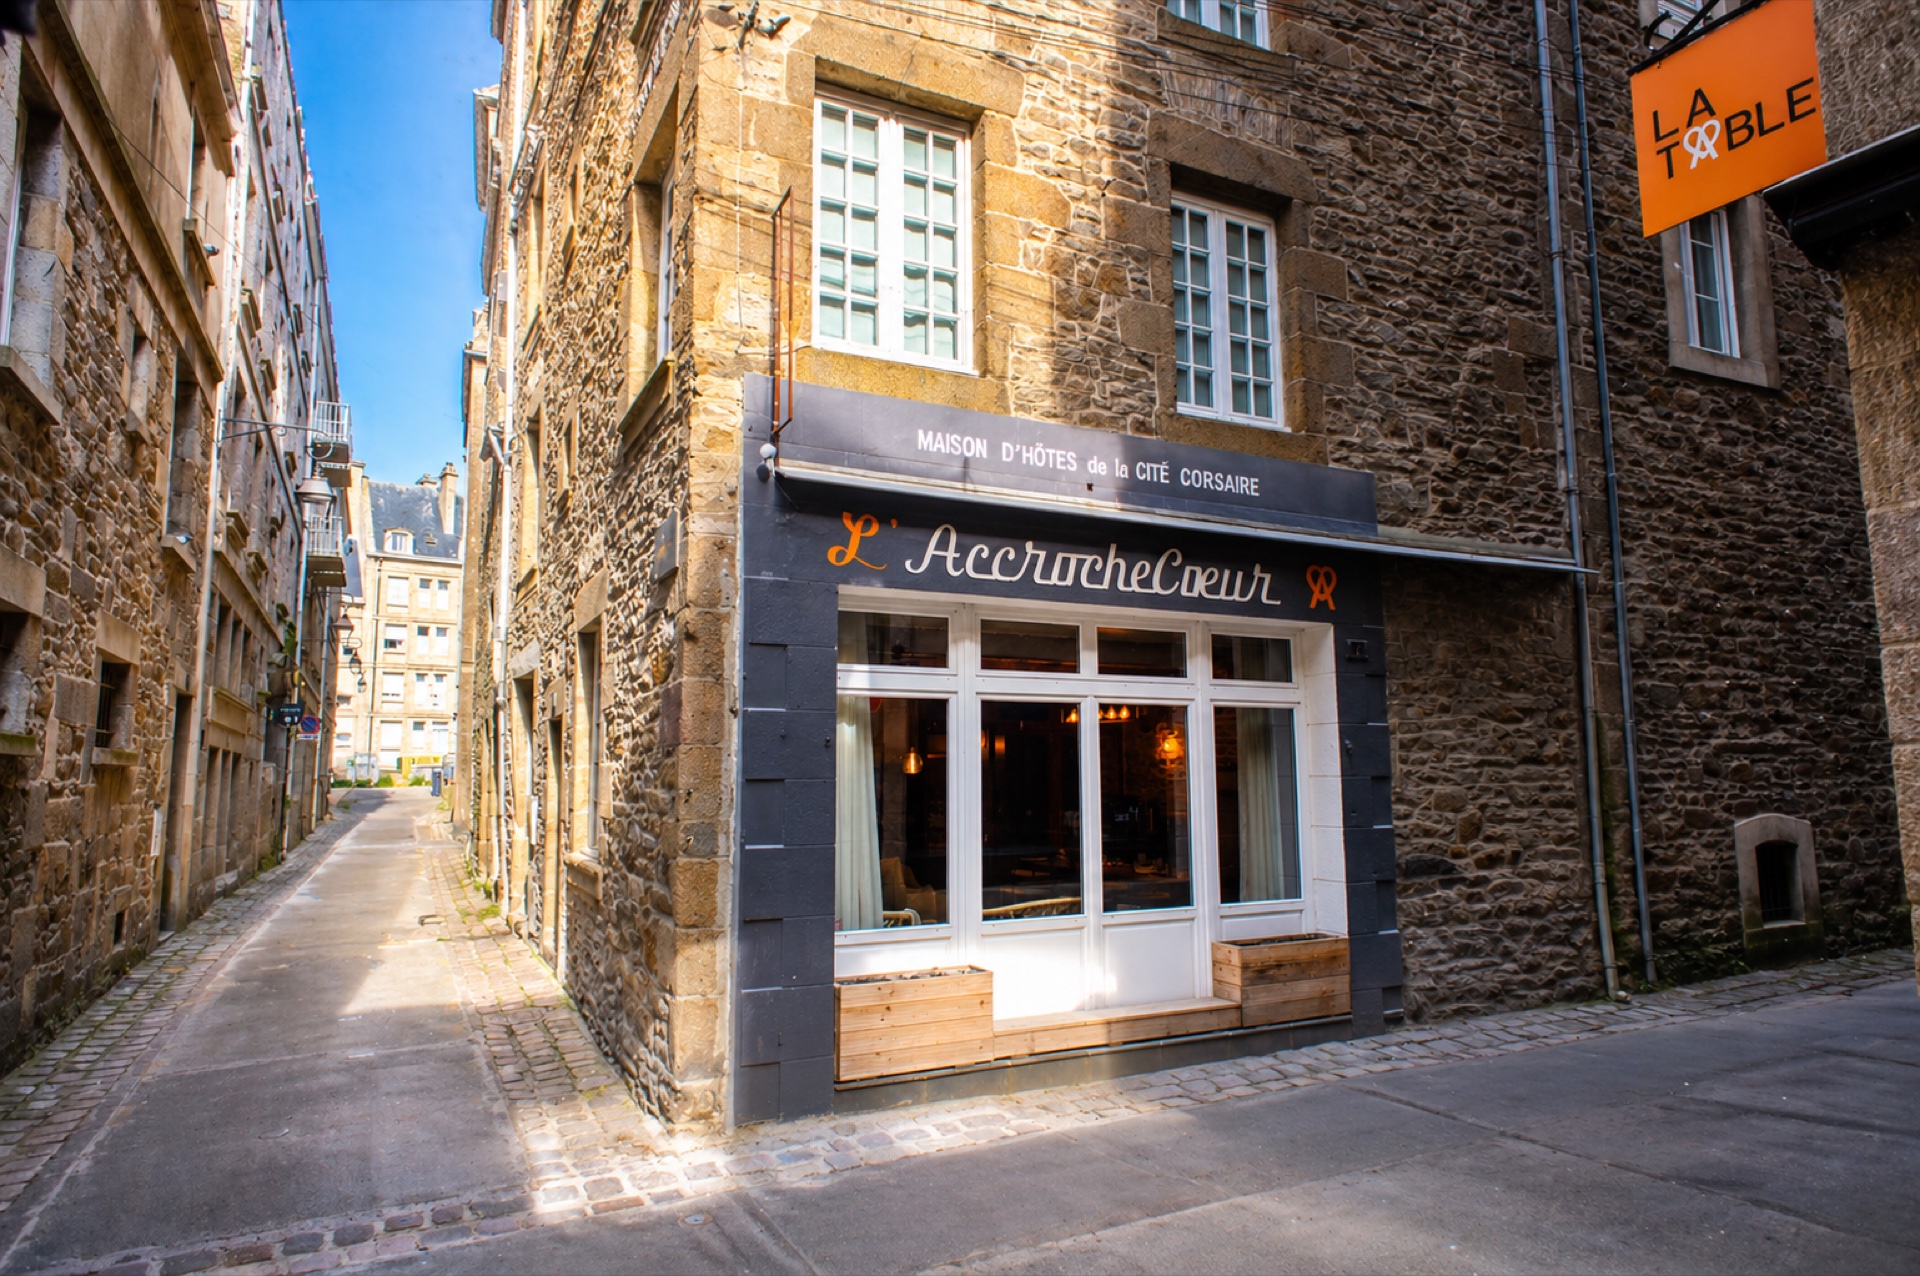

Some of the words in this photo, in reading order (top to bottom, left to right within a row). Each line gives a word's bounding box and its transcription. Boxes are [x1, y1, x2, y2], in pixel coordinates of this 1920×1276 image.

[1652, 87, 1717, 143] LA
[916, 428, 988, 459] MAISON
[1001, 441, 1078, 472] D'HÔTES
[1086, 455, 1107, 476] de
[1114, 458, 1129, 479] la
[1135, 460, 1170, 484] CITÉ
[1180, 467, 1260, 497] CORSAIRE
